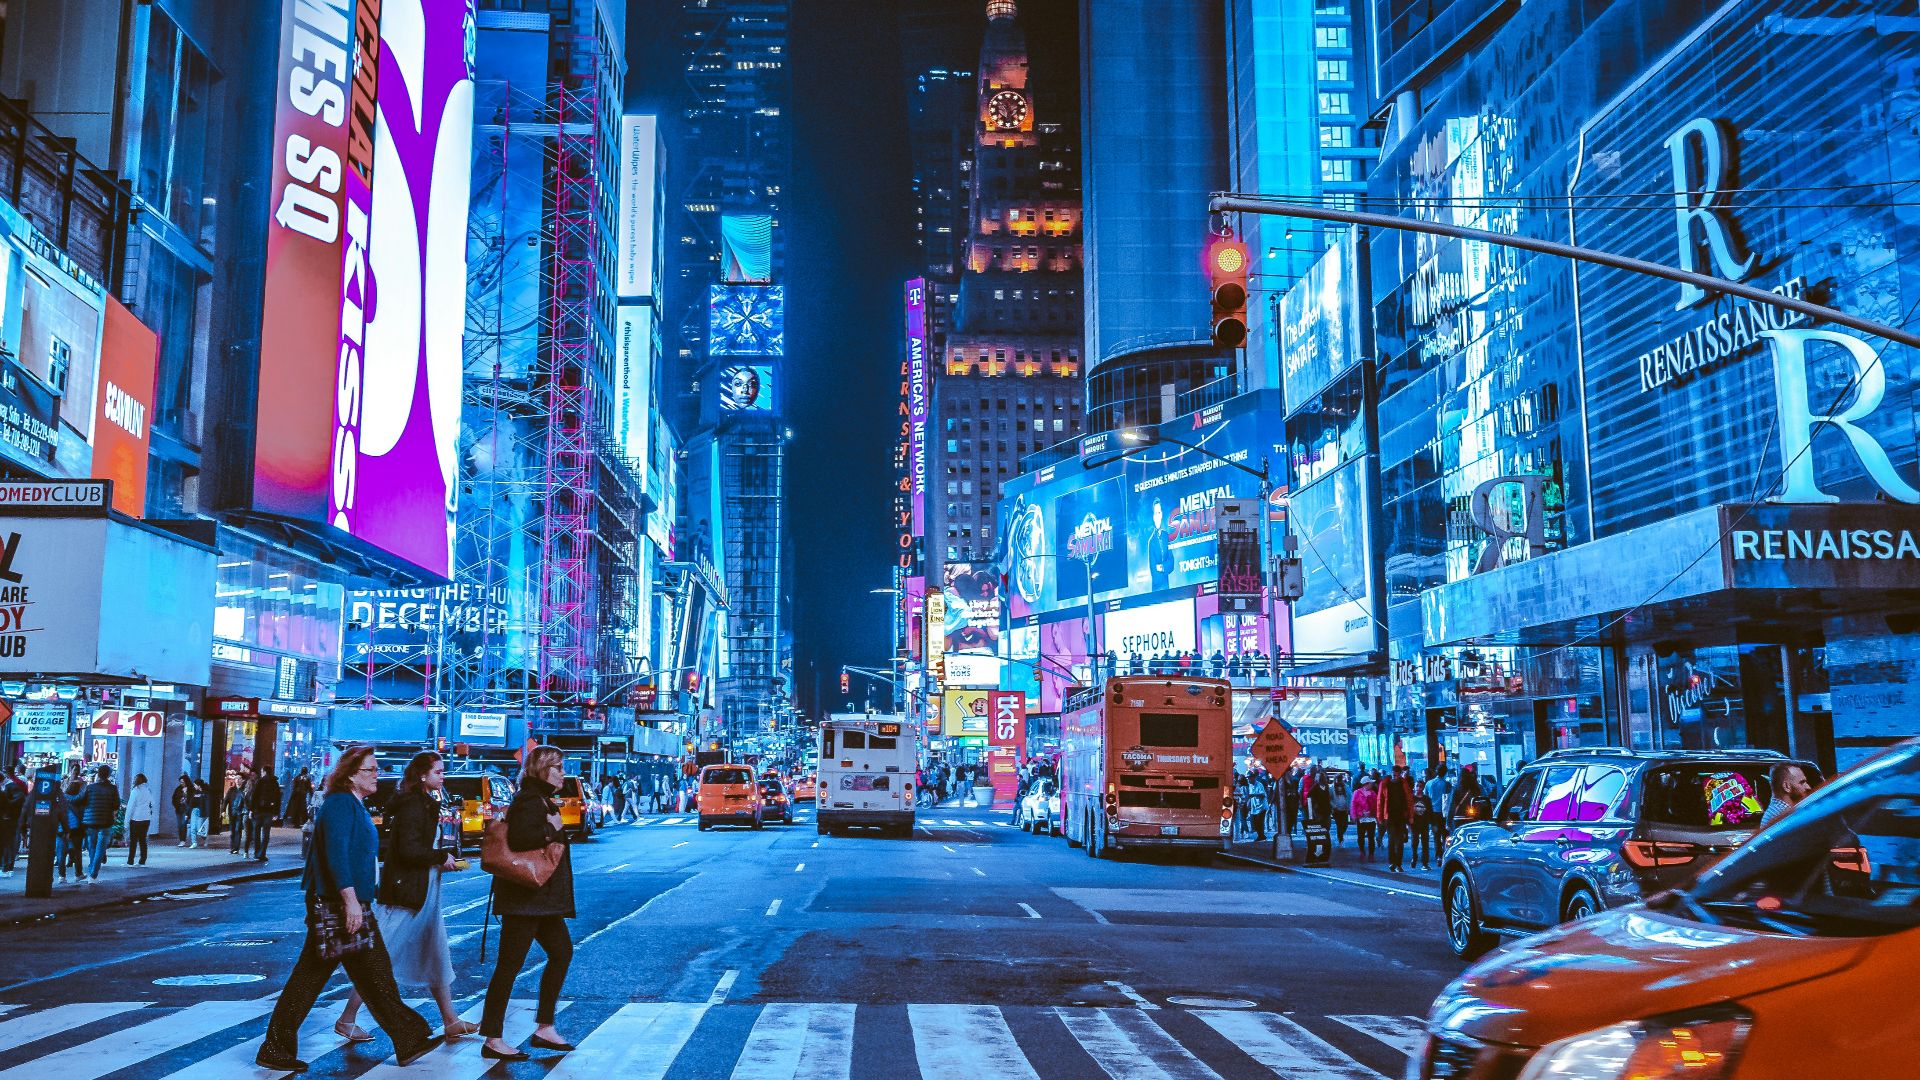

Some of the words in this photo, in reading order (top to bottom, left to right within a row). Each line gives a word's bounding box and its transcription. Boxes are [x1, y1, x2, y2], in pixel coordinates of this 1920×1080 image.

[275, 134, 342, 243] SQ
[1664, 118, 1757, 311] R
[1639, 276, 1806, 394] RENAISSANCE
[1287, 343, 1308, 378] SANTA
[1307, 334, 1318, 358] FE
[911, 338, 924, 416] AMERICA'S
[899, 361, 910, 456] ERNST
[1202, 404, 1224, 417] MARRIOTT
[1202, 414, 1222, 425] MARQUIS
[1760, 328, 1920, 505] R
[913, 421, 925, 496] NETWORK
[1179, 484, 1235, 514] MENTAL
[1074, 517, 1113, 539] MENTAL
[1066, 532, 1113, 560] SAMURAI
[1179, 556, 1206, 572] TONIGHT
[1220, 575, 1259, 592] RISE
[353, 602, 508, 636] DECEMBER
[930, 615, 944, 623] KING
[1241, 615, 1258, 627] ONE
[391, 645, 409, 654] ONE
[1122, 630, 1175, 654] SEPHORA
[1242, 636, 1258, 651] ONE
[1395, 660, 1413, 687] Lids
[1426, 655, 1446, 684] Lids
[17, 717, 65, 726] LUGGAGE
[997, 694, 1020, 740] tkts
[1265, 733, 1284, 741] ROAD
[1265, 744, 1284, 752] WORK
[1156, 755, 1191, 764] THURSDAYS
